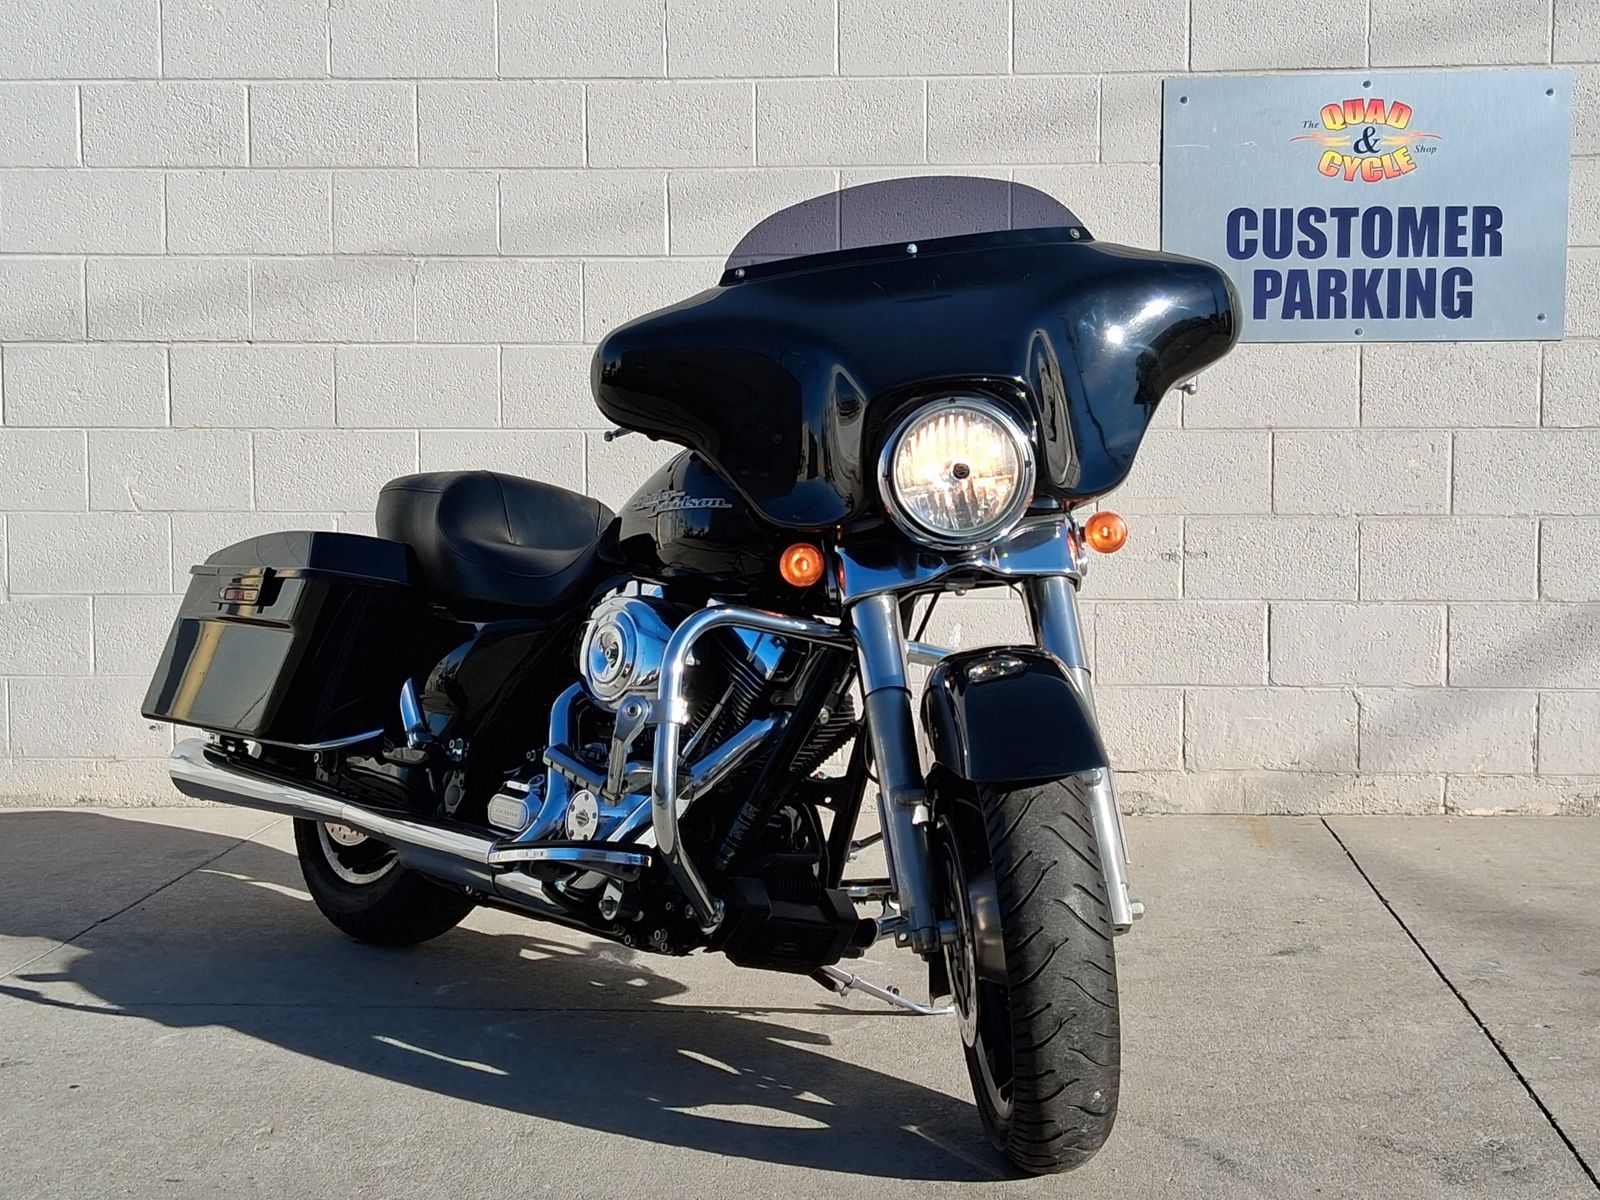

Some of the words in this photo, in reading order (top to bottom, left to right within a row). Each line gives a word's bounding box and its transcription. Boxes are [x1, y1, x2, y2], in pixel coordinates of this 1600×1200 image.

[1302, 120, 1319, 129] The
[1319, 98, 1413, 131] QUAD
[1353, 126, 1381, 154] &
[1414, 145, 1437, 155] Shop
[1317, 146, 1418, 183] CYCLE
[1226, 206, 1503, 260] CUSTOMER
[1253, 267, 1473, 320] PARKING
